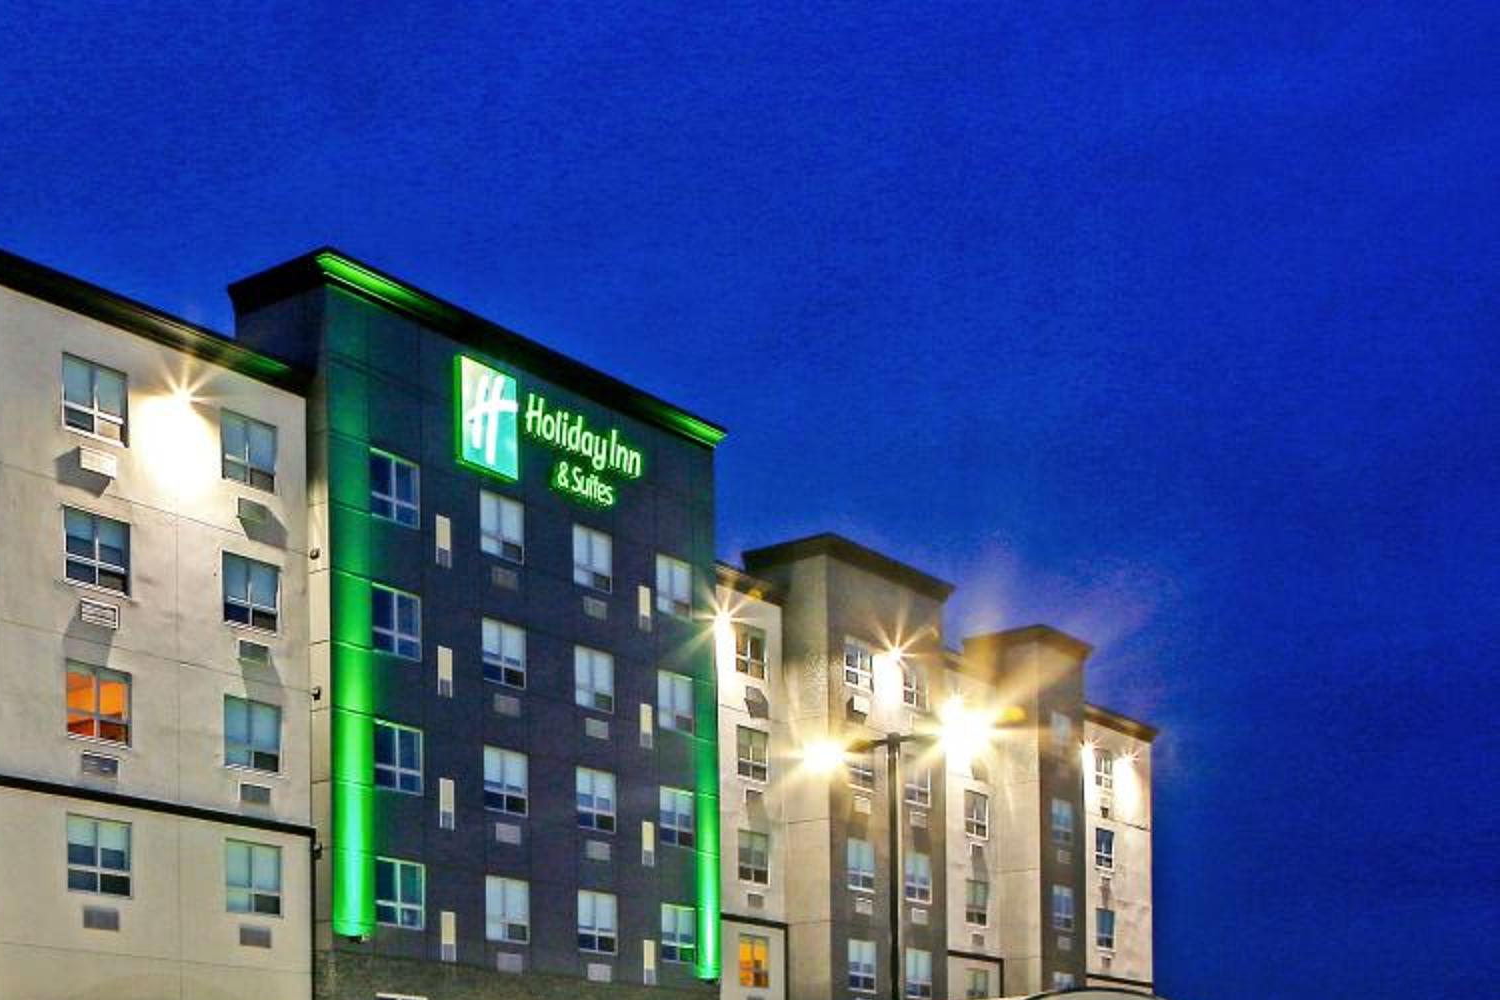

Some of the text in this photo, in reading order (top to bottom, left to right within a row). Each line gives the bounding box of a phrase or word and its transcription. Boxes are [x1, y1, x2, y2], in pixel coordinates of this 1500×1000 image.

[525, 392, 641, 477] Holiday Inn
[556, 461, 614, 505] & Suites
